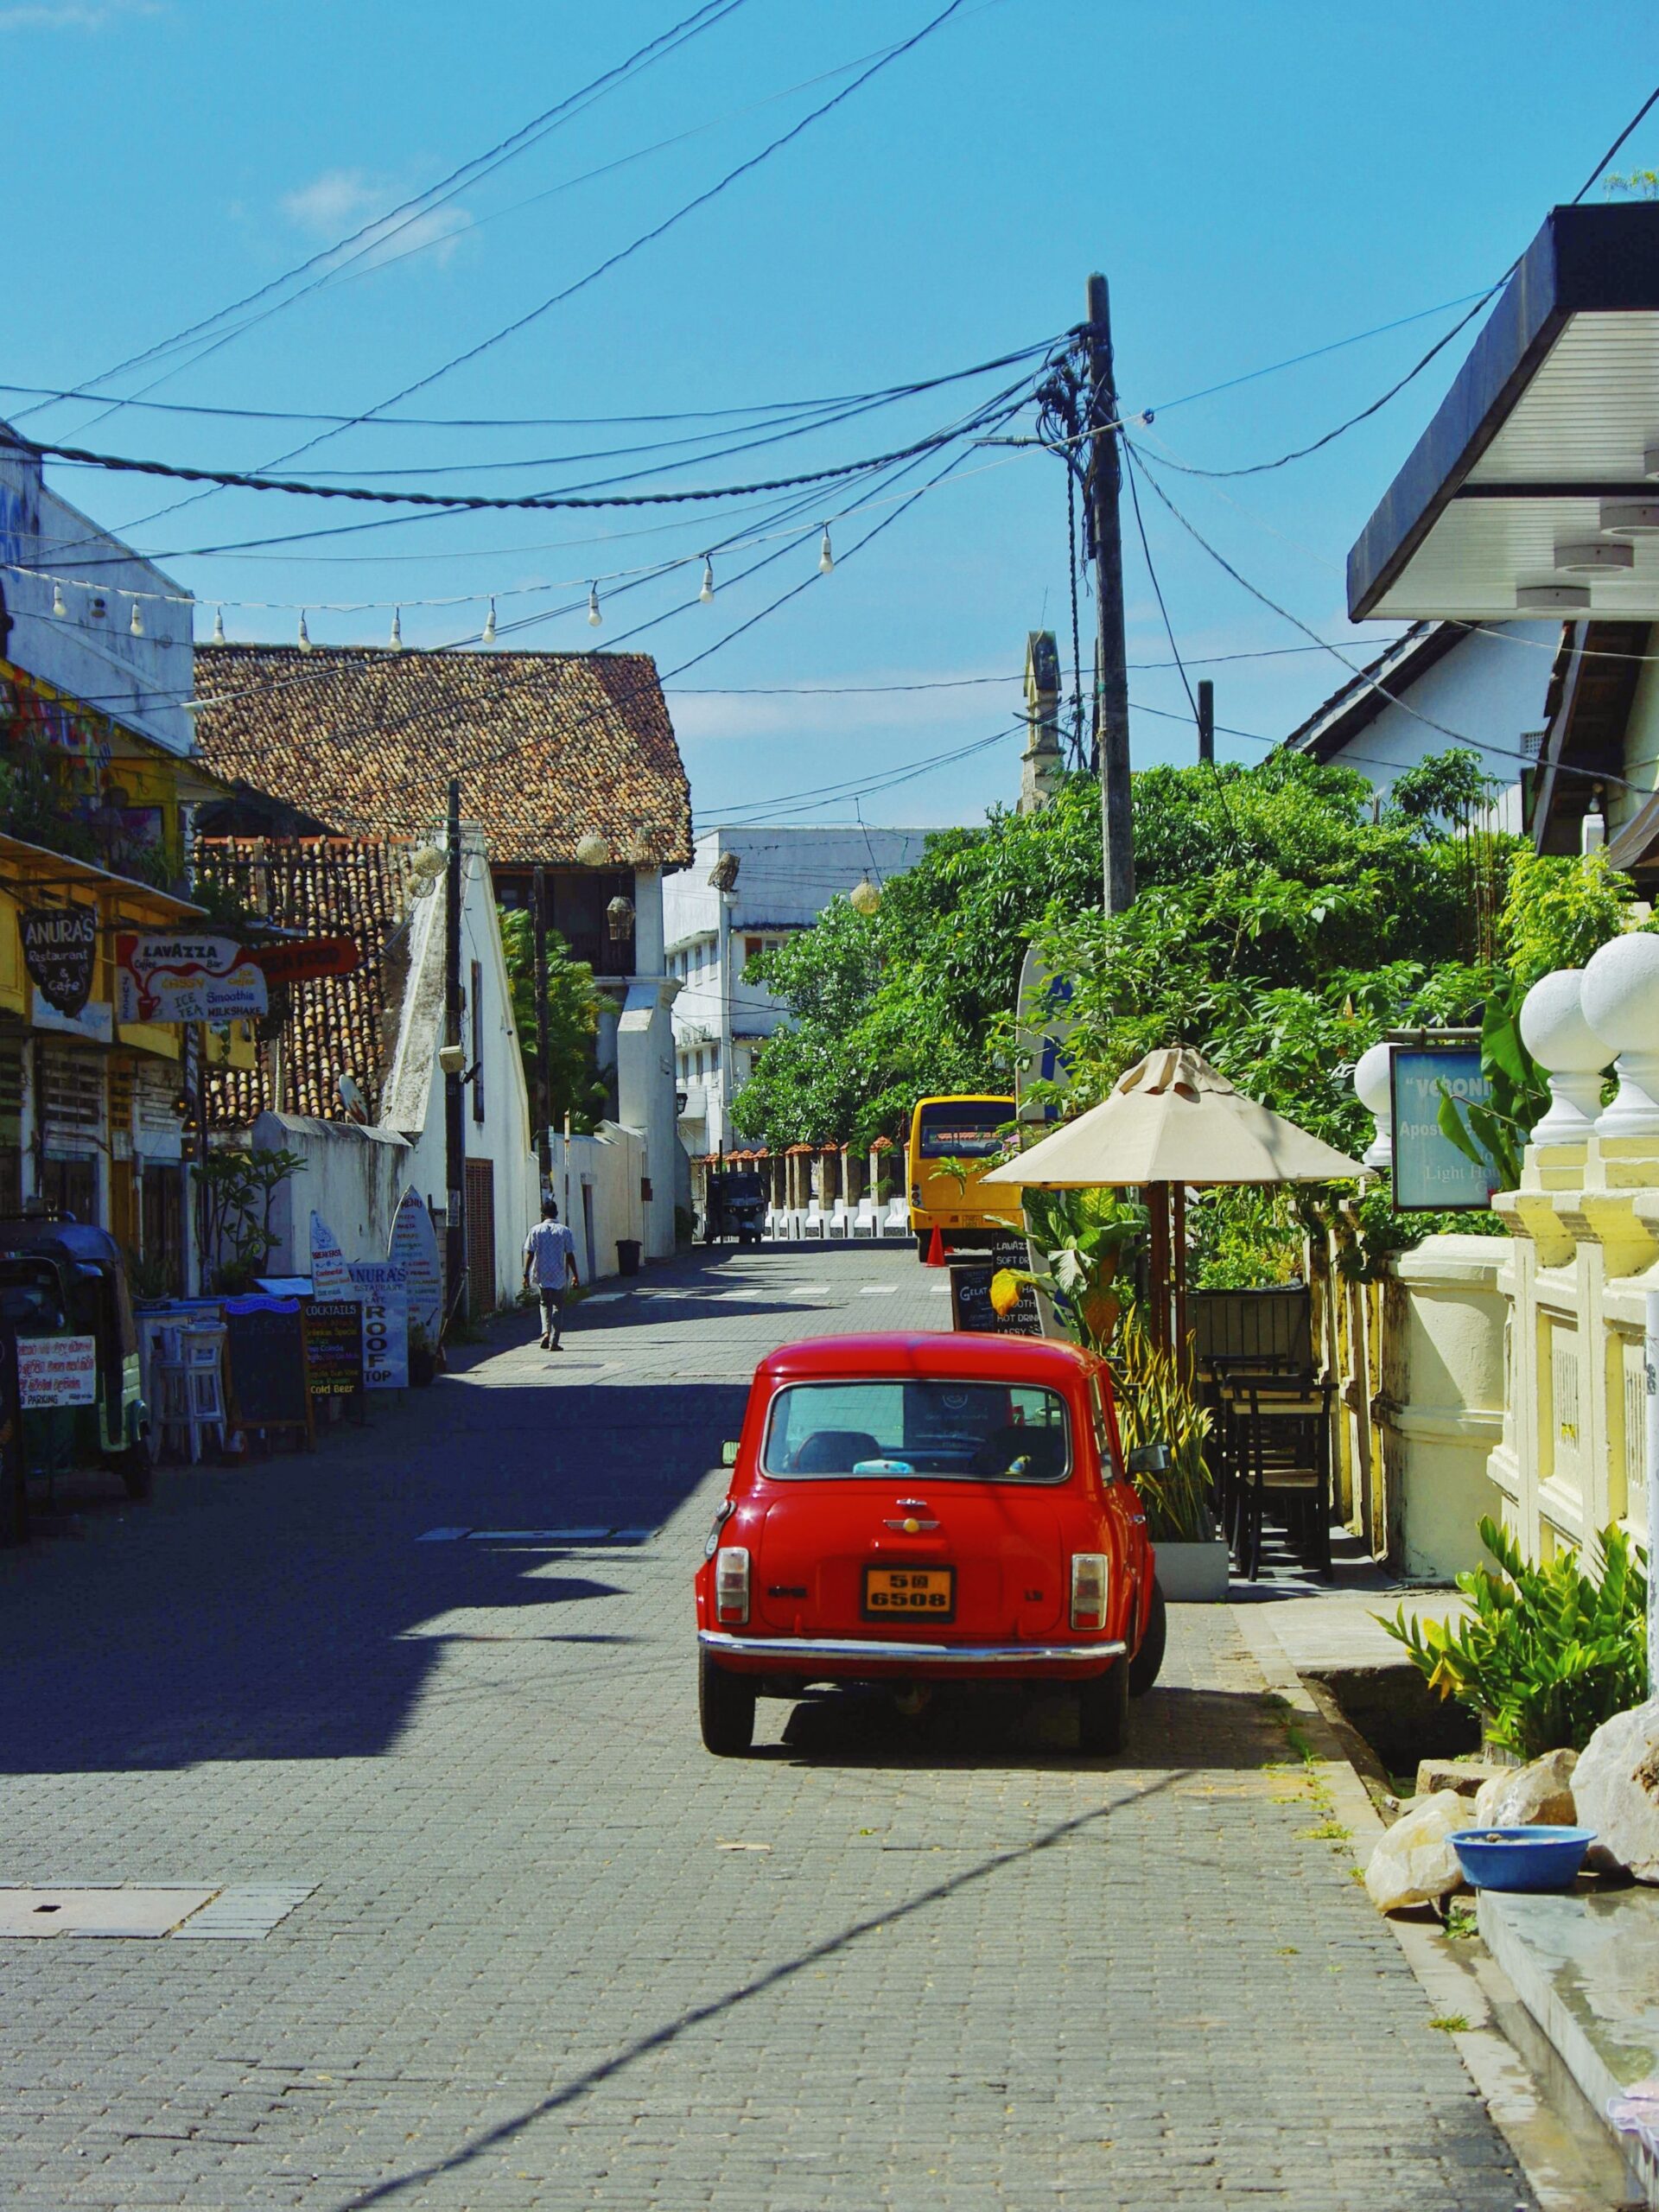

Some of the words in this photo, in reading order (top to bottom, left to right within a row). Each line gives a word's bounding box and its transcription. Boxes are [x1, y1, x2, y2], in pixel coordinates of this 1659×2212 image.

[26, 916, 94, 946] ANURA'S
[29, 950, 88, 963] Restaurant
[143, 943, 218, 958] LAVAZZA
[207, 958, 223, 969] Bar
[175, 992, 197, 1008] ICE
[207, 990, 255, 1004] Smoothie
[178, 1005, 204, 1019] TEA
[1426, 1166, 1465, 1183] Light
[1471, 1165, 1501, 1179] Hou
[400, 1197, 423, 1209] MENU
[312, 1249, 342, 1259] BREAKFAST
[996, 1256, 1016, 1265] SOFT
[354, 1283, 402, 1292] ESTAURANT
[960, 1286, 991, 1301] GELAT
[305, 1306, 357, 1316] COCKTAILS
[996, 1314, 1016, 1323] HOT
[365, 1306, 387, 1368] ROOF
[364, 1371, 391, 1382] TOP
[310, 1385, 331, 1394] Cold
[334, 1384, 355, 1394] Beer
[28, 1395, 58, 1404] PARKING
[890, 1575, 908, 1587] 5
[871, 1592, 946, 1606] 6508
